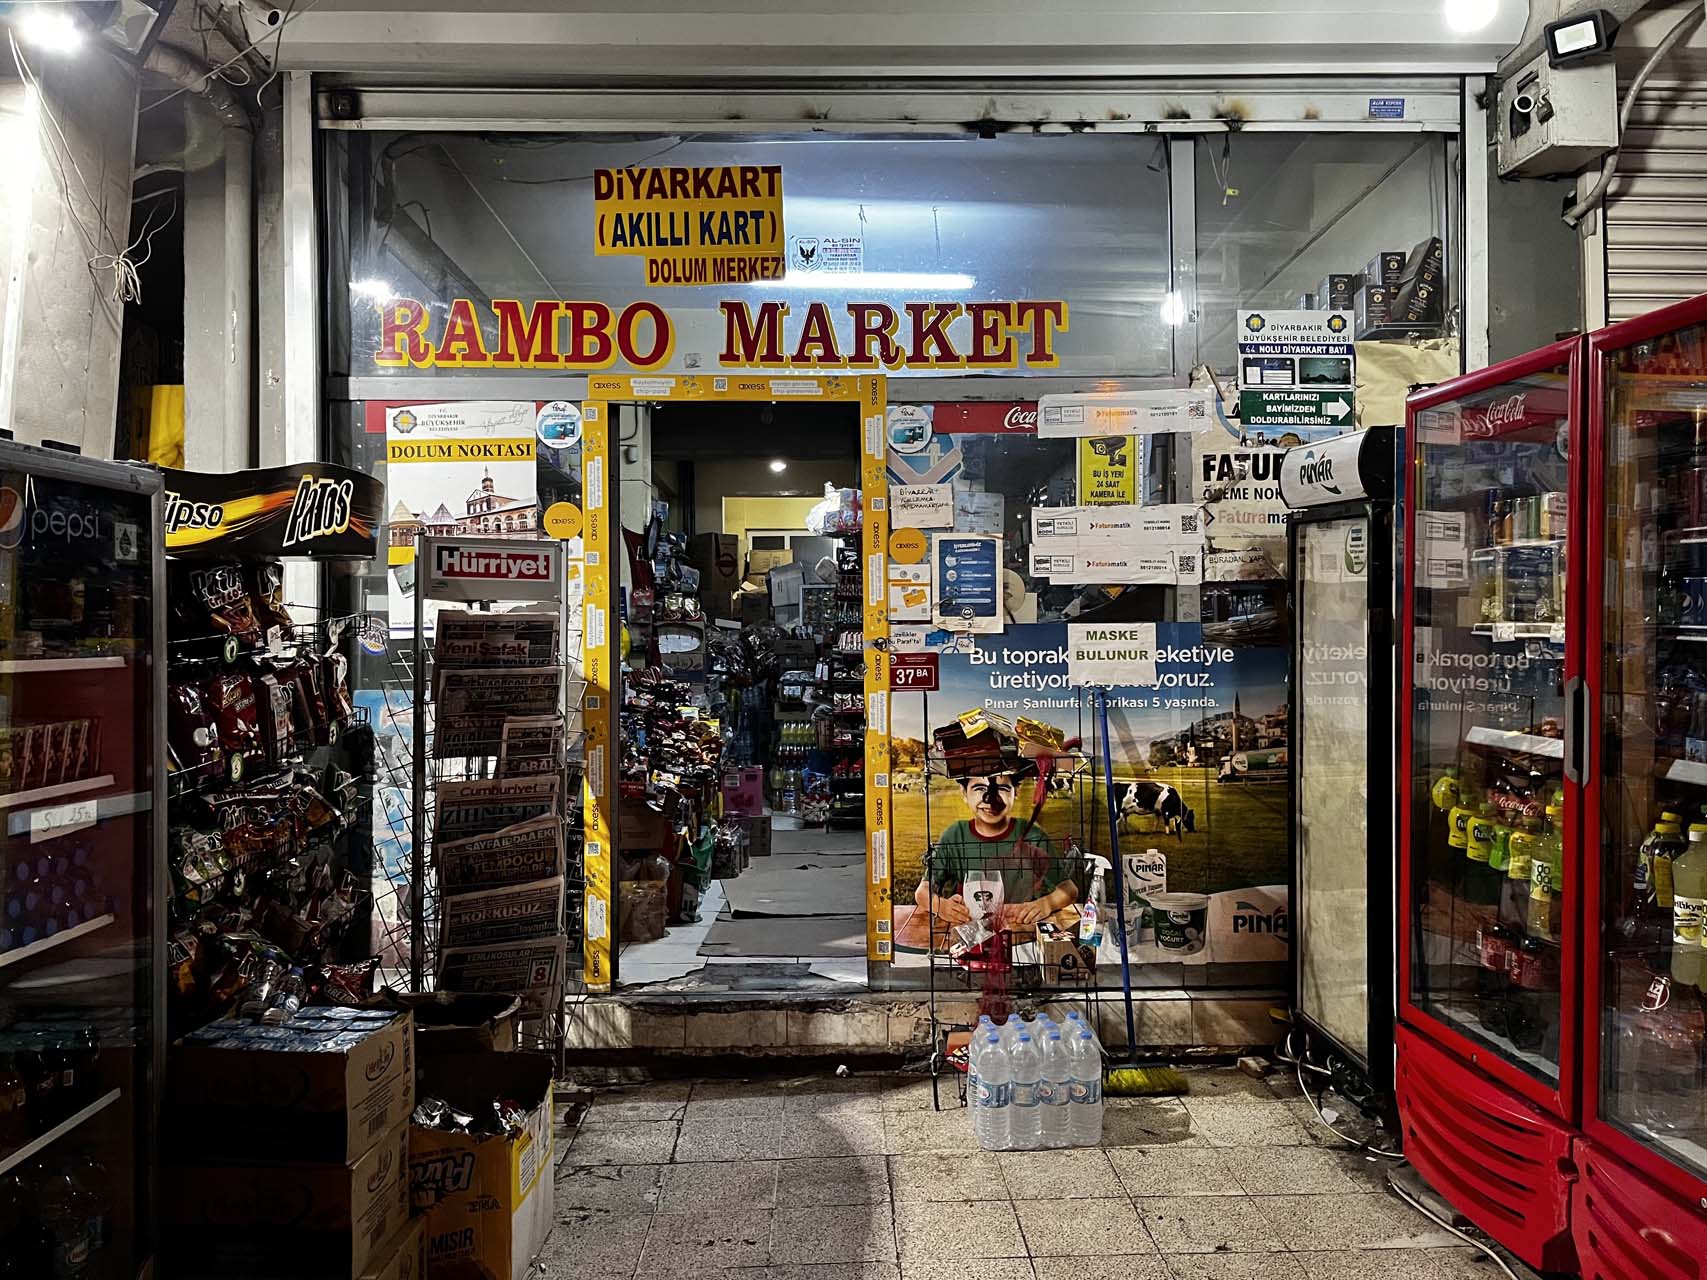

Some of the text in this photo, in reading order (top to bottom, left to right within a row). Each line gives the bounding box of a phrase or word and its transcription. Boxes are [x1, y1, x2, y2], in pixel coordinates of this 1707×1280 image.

[649, 258, 706, 283] DOLUM
[374, 299, 1070, 370] RAMBO MARKET
[1300, 334, 1350, 342] BELEDİYESİ
[1282, 344, 1326, 354] DİYARKART
[1329, 344, 1347, 354] BAYİ
[1266, 404, 1316, 412] BAYİMİZDEN
[1250, 414, 1332, 424] DOLDURABİLİRSİNİZ
[391, 444, 531, 459] DOLUM NOKTASI
[1103, 469, 1109, 478] İŞ
[1111, 469, 1124, 477] YERİ
[1116, 489, 1126, 498] İLE
[32, 509, 99, 544] pepsi
[552, 517, 575, 525] axess
[442, 551, 548, 578] Hürriyet
[1086, 630, 1138, 640] MASKE
[970, 648, 996, 665] Bu
[1002, 646, 1068, 667] toprak
[1076, 650, 1149, 661] BULUNUR
[590, 657, 598, 685] axess
[896, 669, 928, 684] 37 BA
[990, 671, 1072, 692] üretiyor,
[984, 699, 1018, 709] Pınar
[1023, 697, 1082, 710] Şanlıurfa
[1152, 697, 1160, 708] 5
[1165, 697, 1219, 709] yaşında.
[461, 784, 538, 796] Cumhuriyet
[1136, 864, 1164, 872] PINAR
[461, 902, 541, 922] KORKUSUZ
[534, 967, 546, 981] 8
[431, 1228, 473, 1258] MISIR
